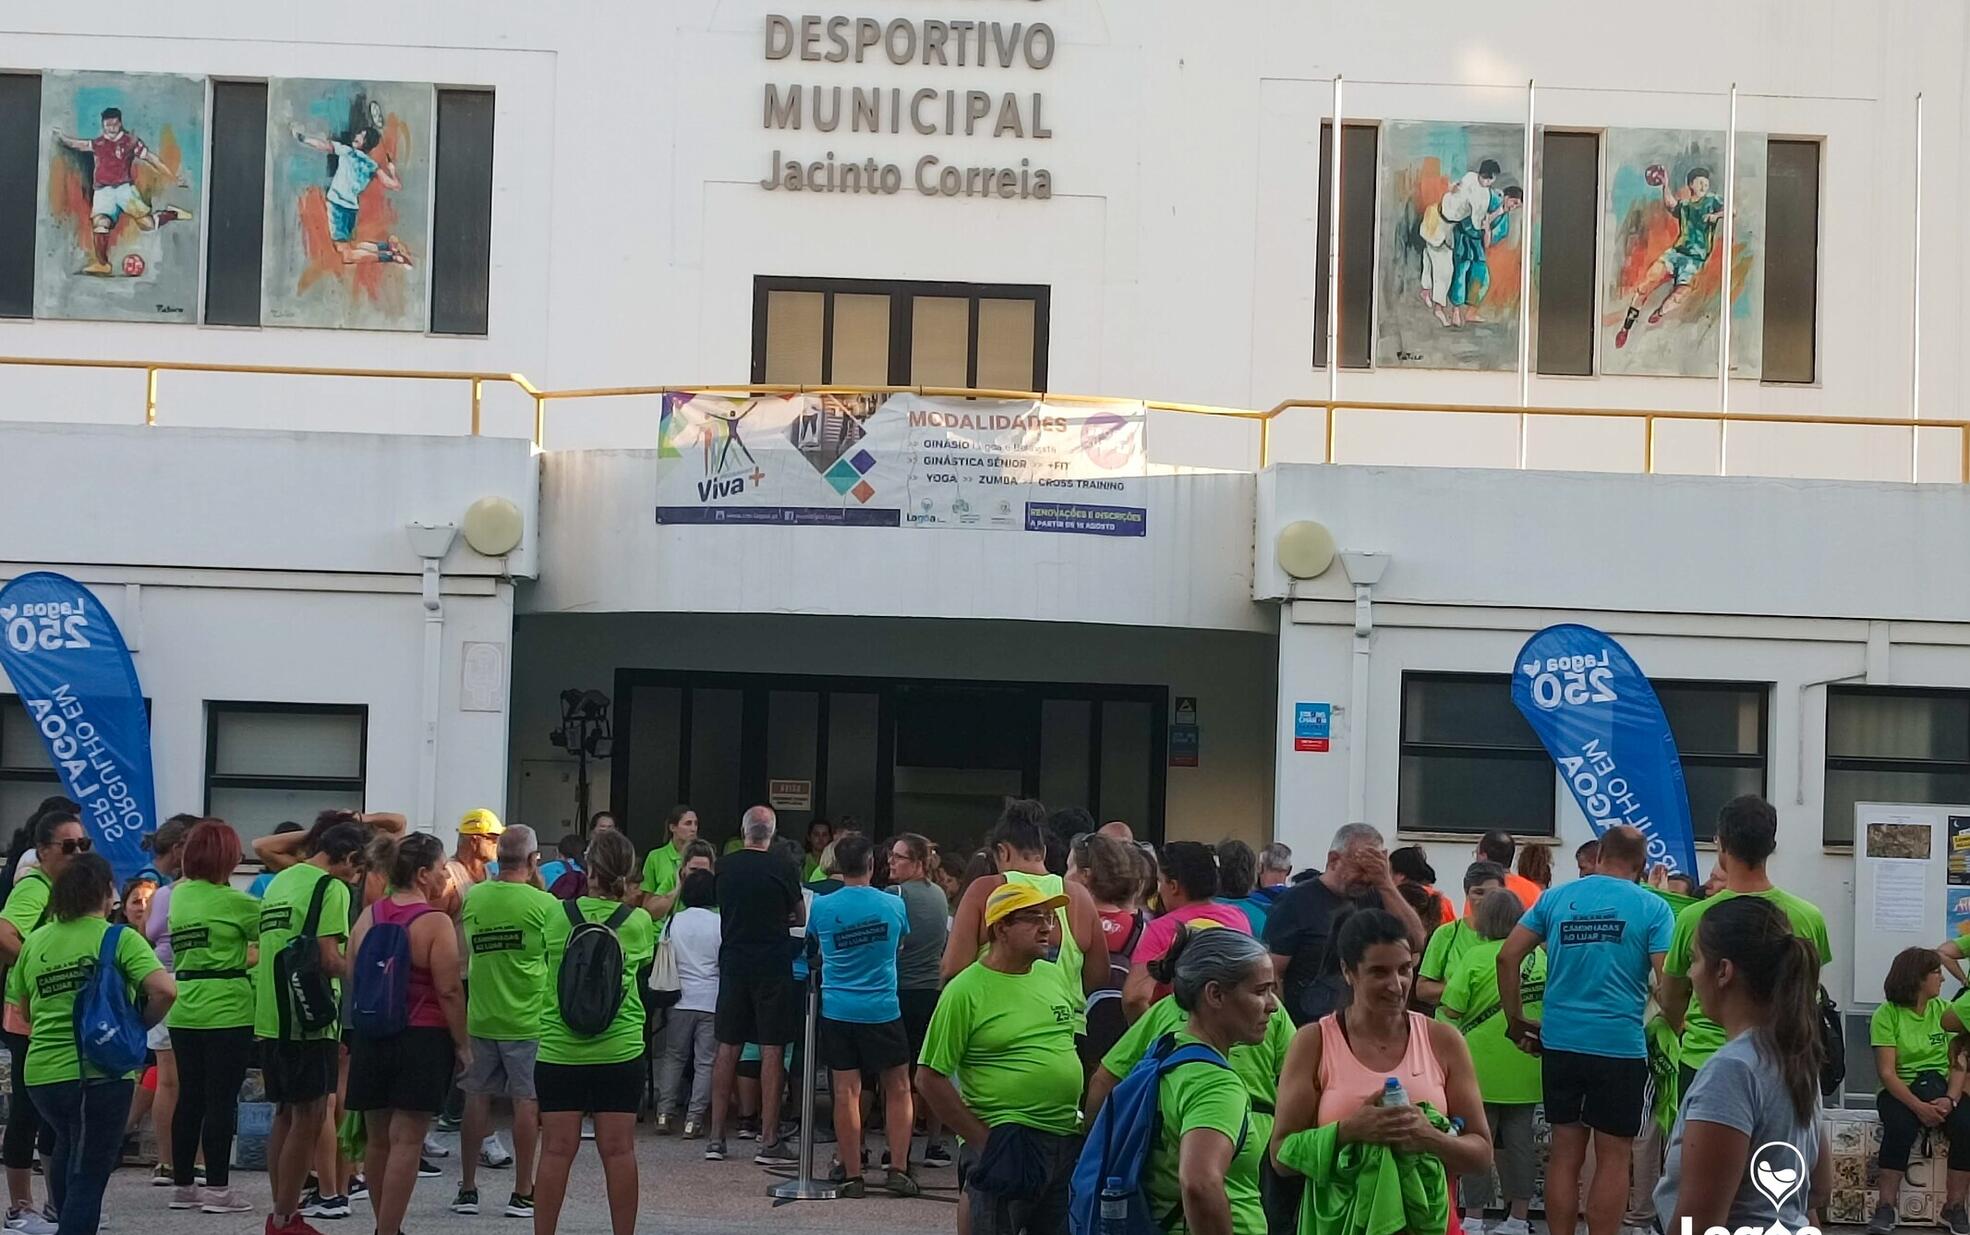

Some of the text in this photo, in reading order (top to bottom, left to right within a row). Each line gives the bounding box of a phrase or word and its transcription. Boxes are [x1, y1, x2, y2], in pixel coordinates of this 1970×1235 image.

[765, 14, 1055, 70] DESPORTIVO
[764, 83, 1052, 139] MUNICIPAL
[760, 150, 1051, 200] Jacinto Correia
[908, 410, 1067, 432] MODALIDADES
[923, 456, 984, 467] GINÁSTICA
[986, 457, 1027, 468] SÉNIOR
[926, 474, 1125, 490] YOGA ZUMBA CROSS TRAINING
